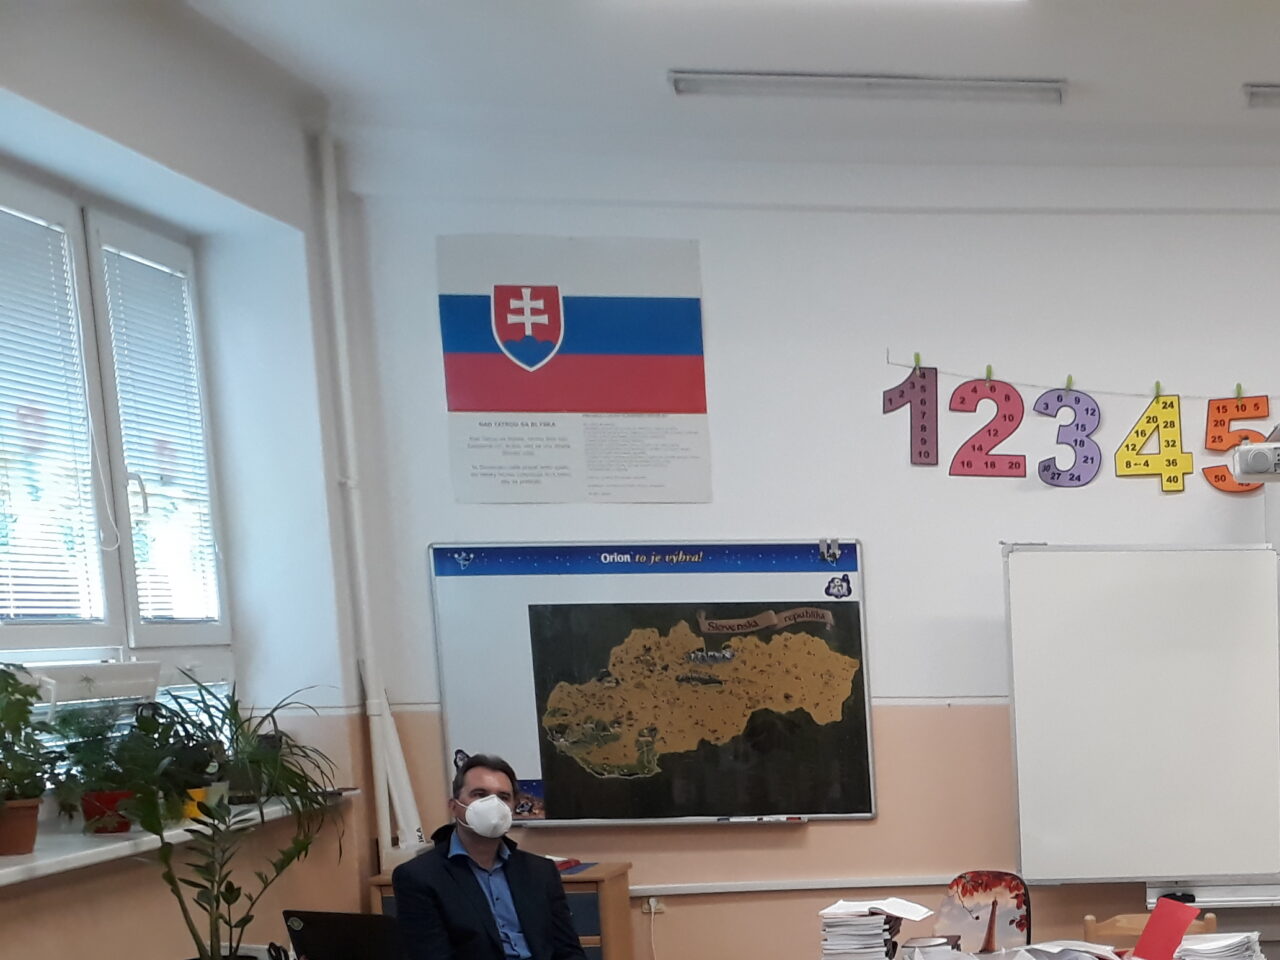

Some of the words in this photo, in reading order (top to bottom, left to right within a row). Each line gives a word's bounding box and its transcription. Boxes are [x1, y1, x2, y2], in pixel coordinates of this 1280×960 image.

[1162, 401, 1174, 409] 24
[1216, 405, 1228, 413] 15
[1235, 404, 1246, 412] 10
[1254, 403, 1260, 411] 5
[1085, 408, 1096, 416] 12
[1003, 414, 1014, 422] 10
[1146, 415, 1158, 424] 20
[1075, 423, 1086, 431] 15
[1163, 420, 1175, 428] 28
[1213, 419, 1225, 427] 20
[883, 367, 938, 466] 1
[949, 379, 1026, 477] 2
[1033, 388, 1101, 487] 3
[1114, 394, 1193, 492] 4
[1202, 395, 1269, 493] 5
[987, 429, 999, 437] 12
[1211, 435, 1223, 443] 25
[1125, 443, 1136, 451] 12
[1164, 439, 1176, 448] 32
[971, 444, 983, 452] 14
[919, 451, 930, 459] 10
[1083, 456, 1094, 464] 21
[1166, 459, 1178, 467] 36
[1050, 472, 1061, 480] 27
[1069, 473, 1081, 482] 24
[1166, 475, 1178, 483] 40
[1214, 474, 1226, 482] 50
[601, 553, 631, 563] Orion
[634, 554, 646, 563] to
[650, 552, 662, 565] je
[665, 551, 703, 566] výhra!
